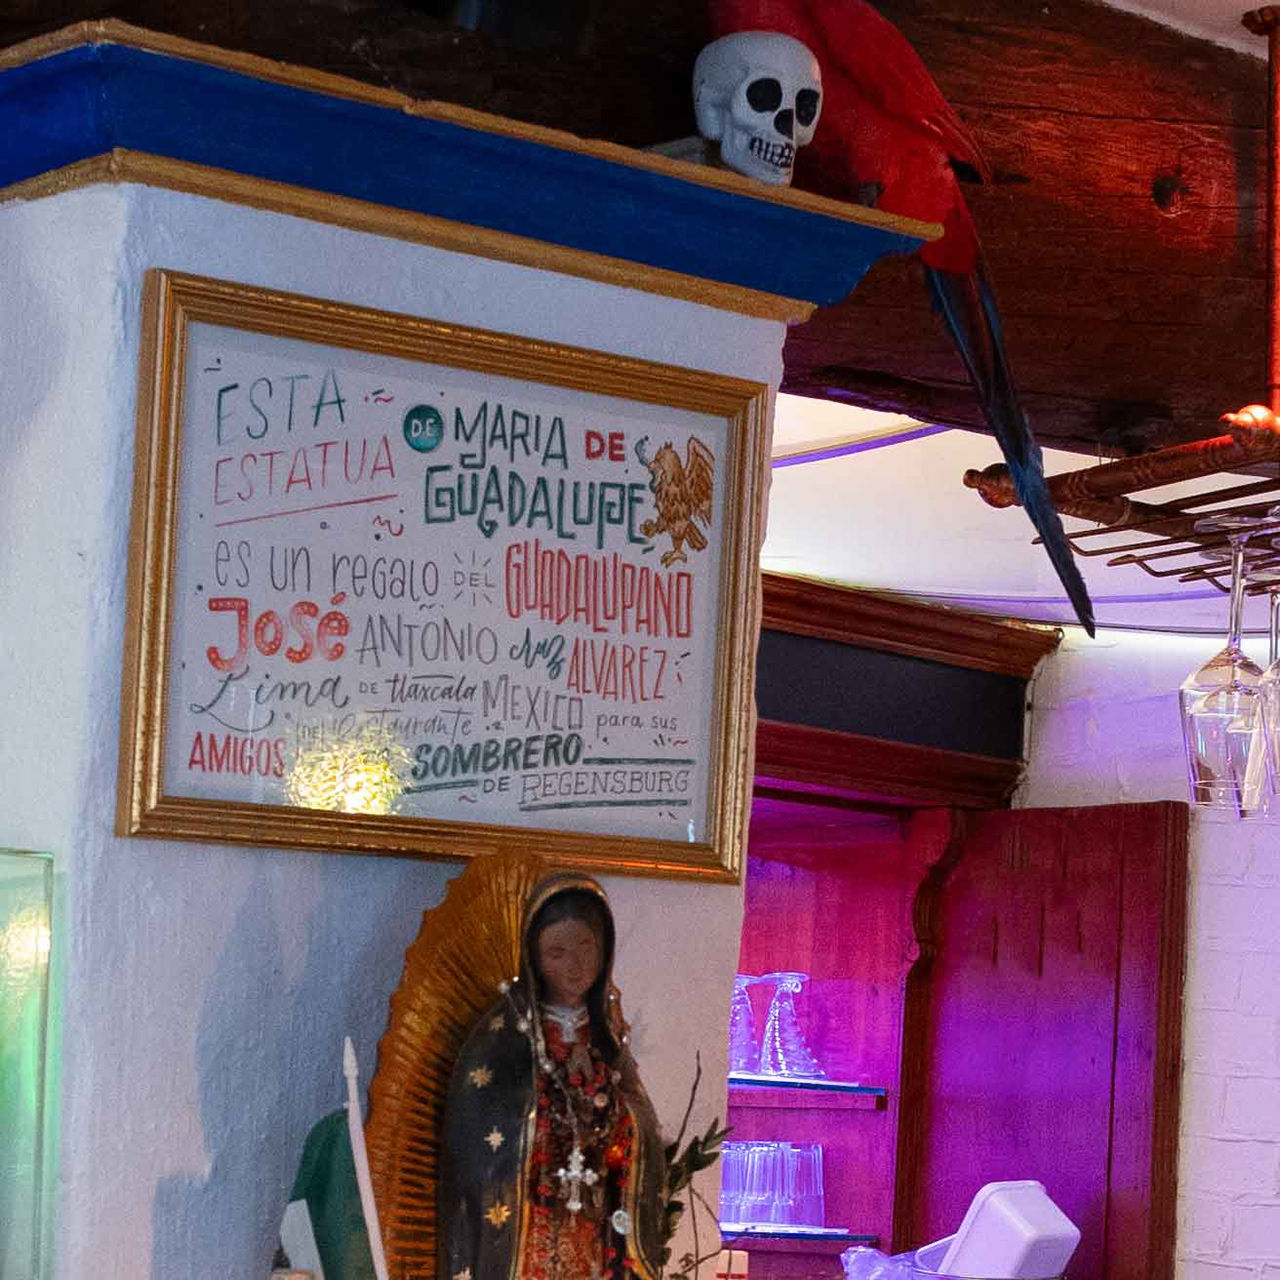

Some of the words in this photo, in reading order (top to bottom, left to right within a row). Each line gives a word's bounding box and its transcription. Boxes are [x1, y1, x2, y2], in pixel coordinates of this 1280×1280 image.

[216, 369, 346, 445] ESTA
[455, 401, 568, 469] MARIA
[584, 429, 626, 462] DE
[213, 435, 396, 504] ESTATUA
[424, 463, 651, 550] GUADALUPE
[215, 540, 251, 588] es
[270, 546, 311, 593] un
[453, 570, 497, 589] DEL
[505, 538, 693, 638] GUADALUPANO
[356, 613, 499, 668] ANTONIO
[566, 637, 668, 704] ALVAREZ
[359, 680, 379, 695] DE
[481, 674, 585, 732] MEXICO
[596, 712, 644, 739] para
[650, 713, 679, 731] sus
[187, 731, 286, 779] AMIGOS
[411, 733, 585, 782] SOMBRERO
[483, 776, 511, 794] DE
[520, 770, 691, 805] REGENSBURG
